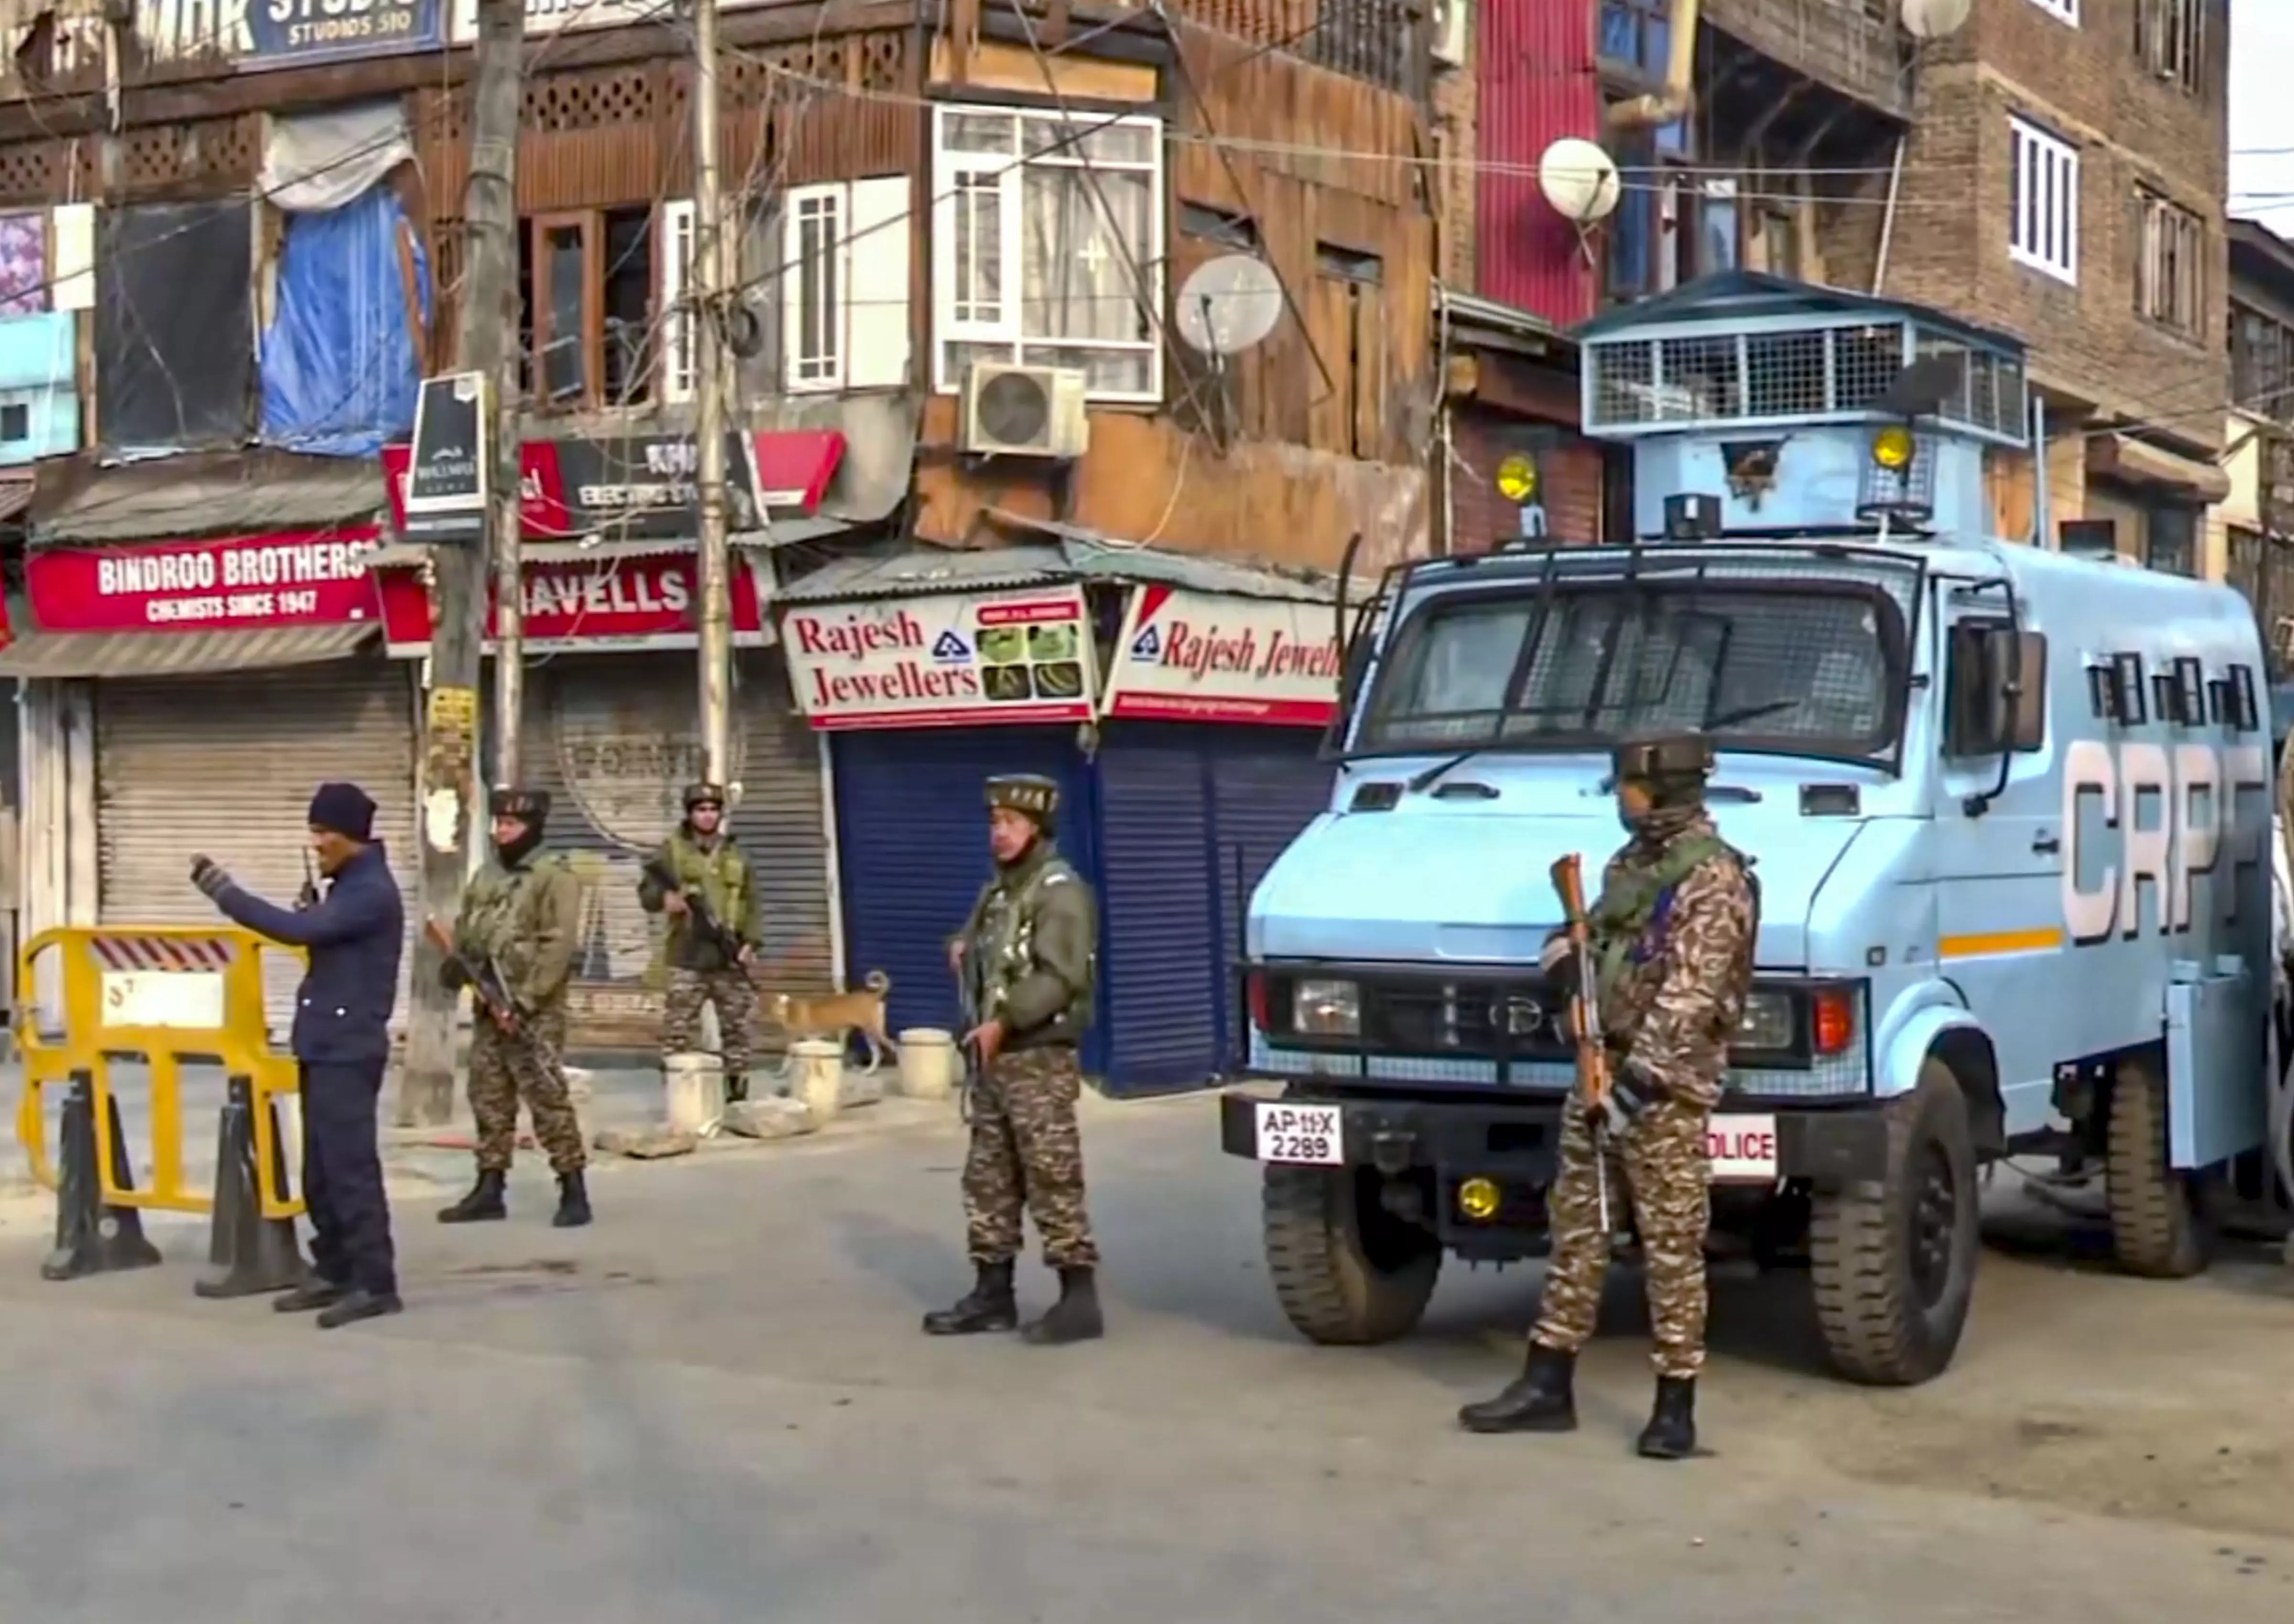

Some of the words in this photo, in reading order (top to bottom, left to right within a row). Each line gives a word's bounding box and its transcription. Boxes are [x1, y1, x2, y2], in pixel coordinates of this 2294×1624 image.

[98, 552, 215, 594] BINDROO
[146, 596, 225, 621] CHEMISTS
[227, 592, 274, 616] SINCE
[278, 590, 317, 614] 1947
[793, 611, 924, 660] Rajesh
[1161, 620, 1255, 683] Rajesh
[812, 661, 978, 707] Jewellers
[2062, 739, 2265, 944] CRPF
[1271, 1134, 1329, 1159] 2289
[1704, 1132, 1774, 1158] OLICE
